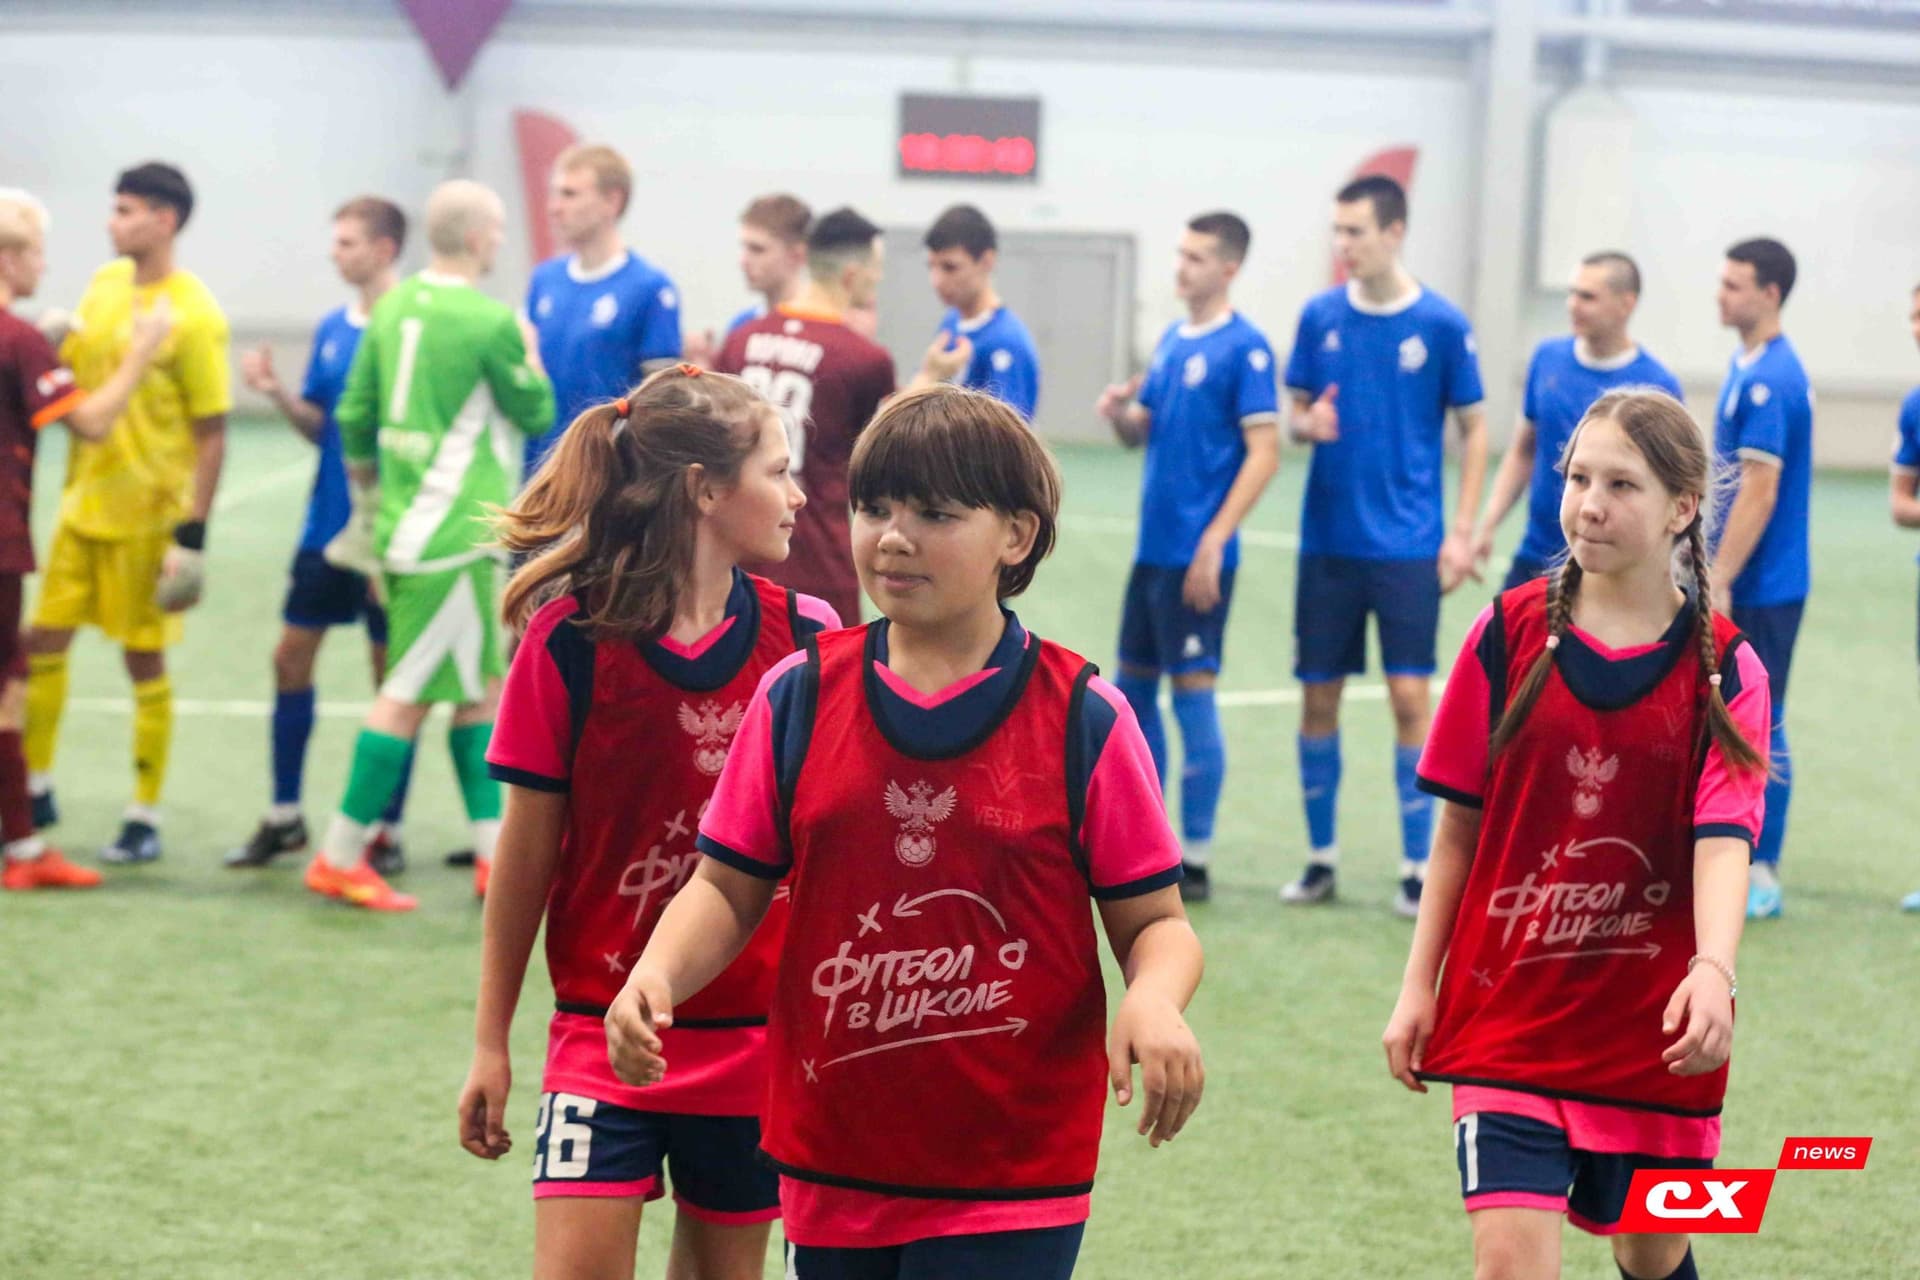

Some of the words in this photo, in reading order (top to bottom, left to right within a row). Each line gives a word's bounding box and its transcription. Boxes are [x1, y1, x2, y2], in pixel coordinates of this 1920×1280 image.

[389, 317, 424, 424] 1
[1487, 872, 1627, 950] ФУТБОЛ
[1542, 912, 1653, 947] ШКОЛЕ
[811, 941, 976, 1038] ФУТБОЛ
[875, 979, 1014, 1033] ШКОЛЕ
